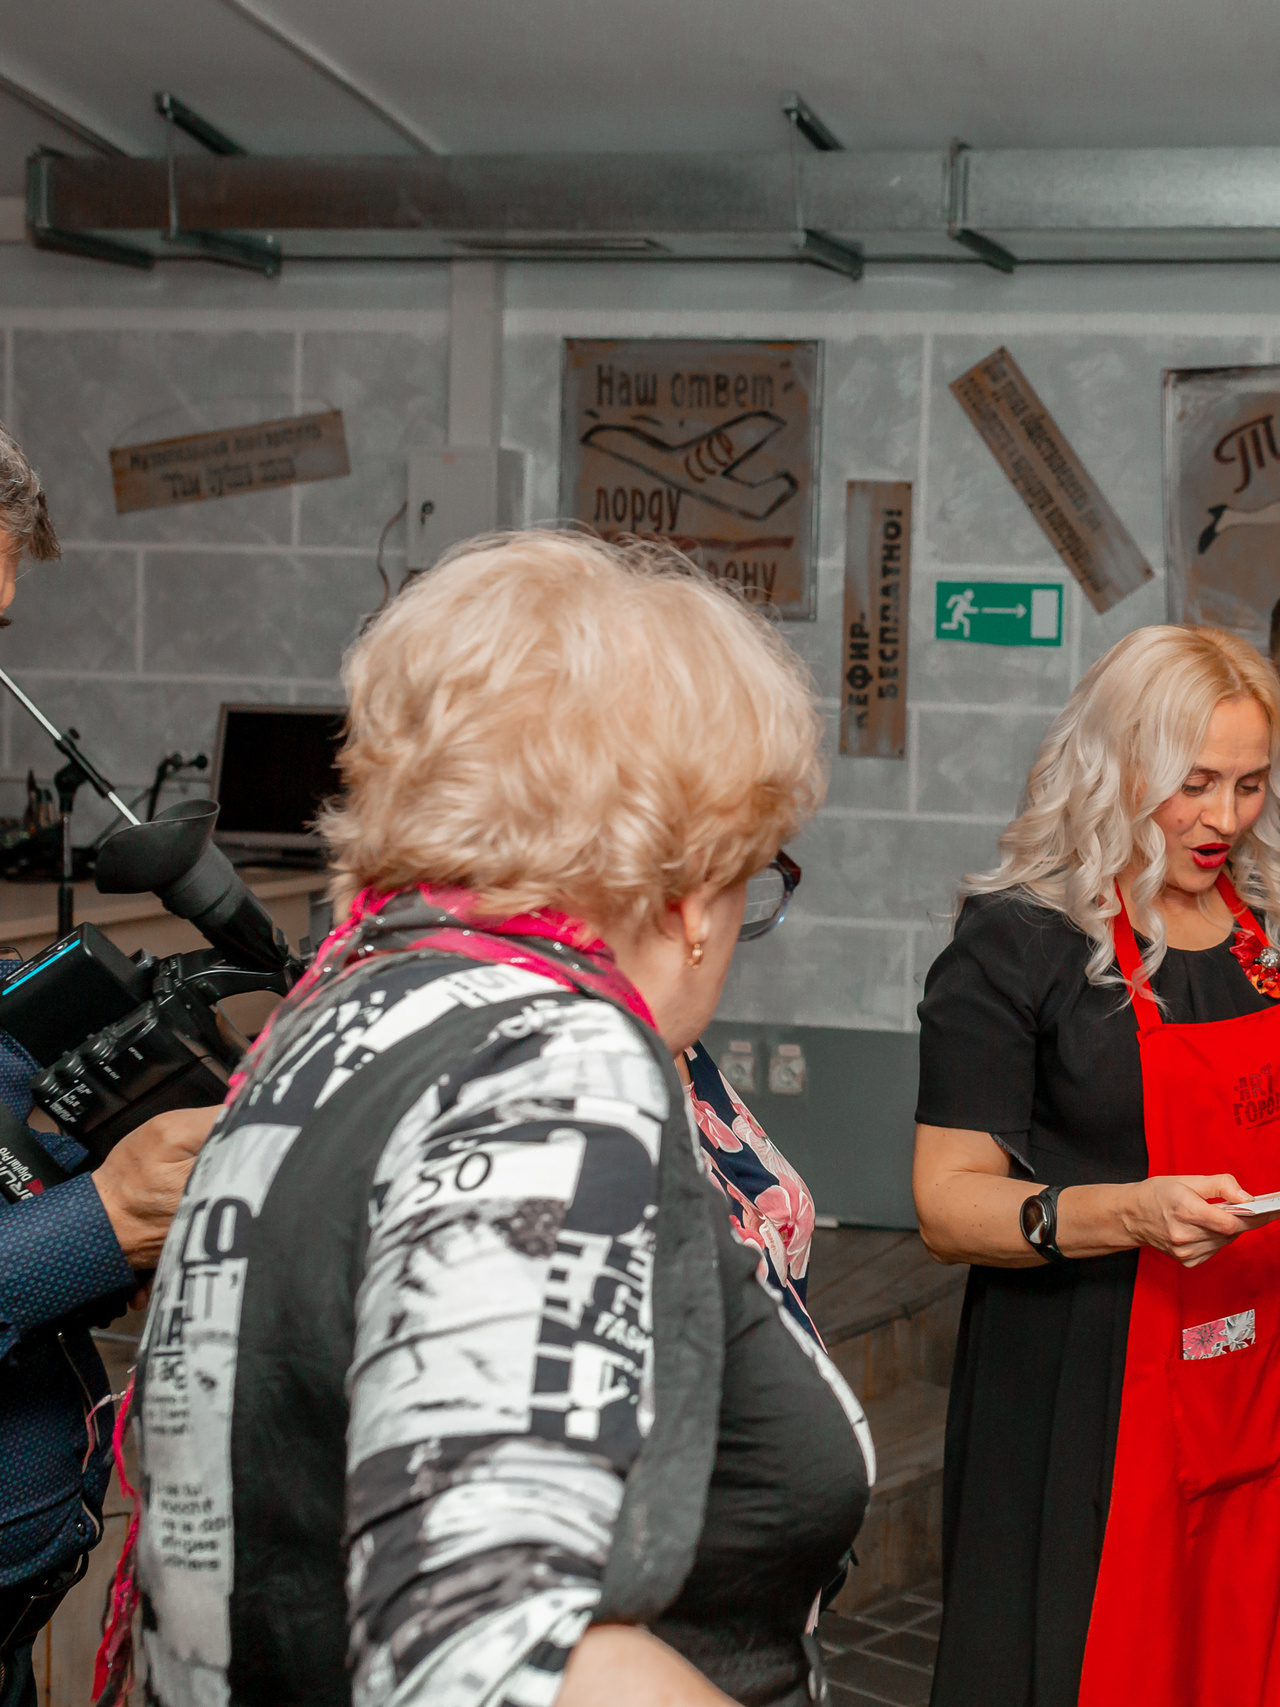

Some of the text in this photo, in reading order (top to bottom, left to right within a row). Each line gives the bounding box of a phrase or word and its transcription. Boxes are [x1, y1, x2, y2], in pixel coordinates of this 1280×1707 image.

[596, 363, 777, 408] Наш ответ
[593, 484, 682, 532] лорду
